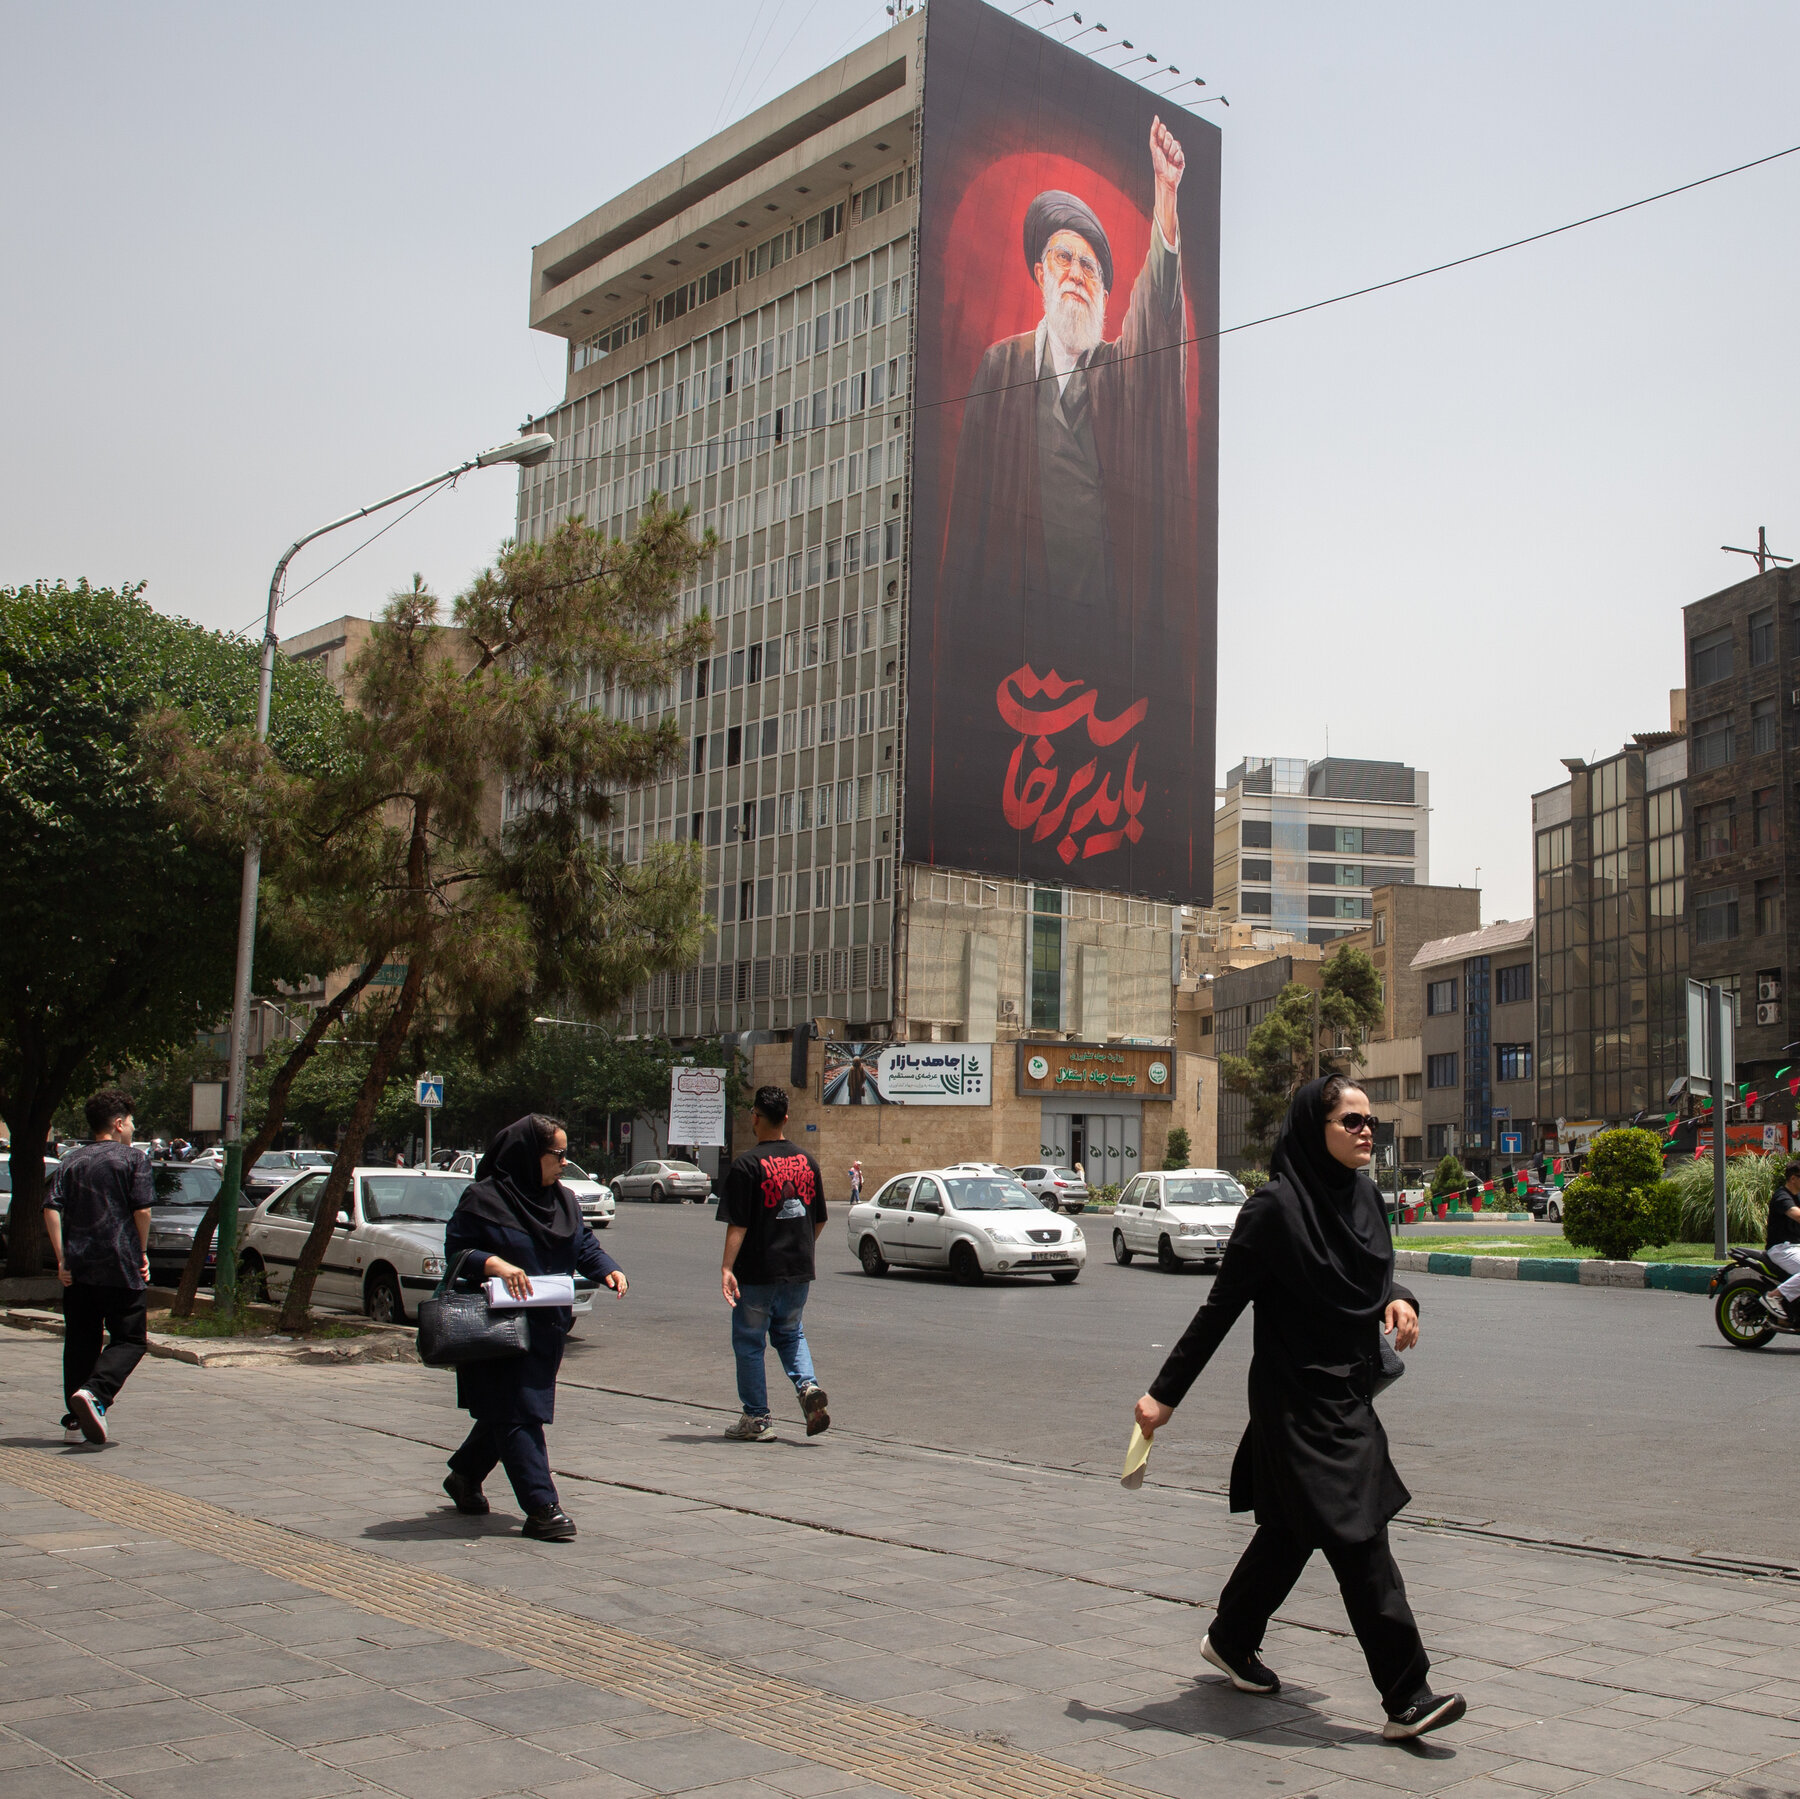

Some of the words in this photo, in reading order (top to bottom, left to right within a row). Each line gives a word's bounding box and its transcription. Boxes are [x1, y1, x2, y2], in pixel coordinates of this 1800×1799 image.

[996, 662, 1149, 866] برخاست
[1068, 741, 1148, 860] باید
[889, 1054, 921, 1071] بازار
[921, 1054, 960, 1071] جاهد
[888, 1072, 915, 1082] مستقیم
[1056, 1066, 1087, 1084] استقلال
[1089, 1068, 1109, 1087] جهاد
[760, 1153, 811, 1178] NEVER
